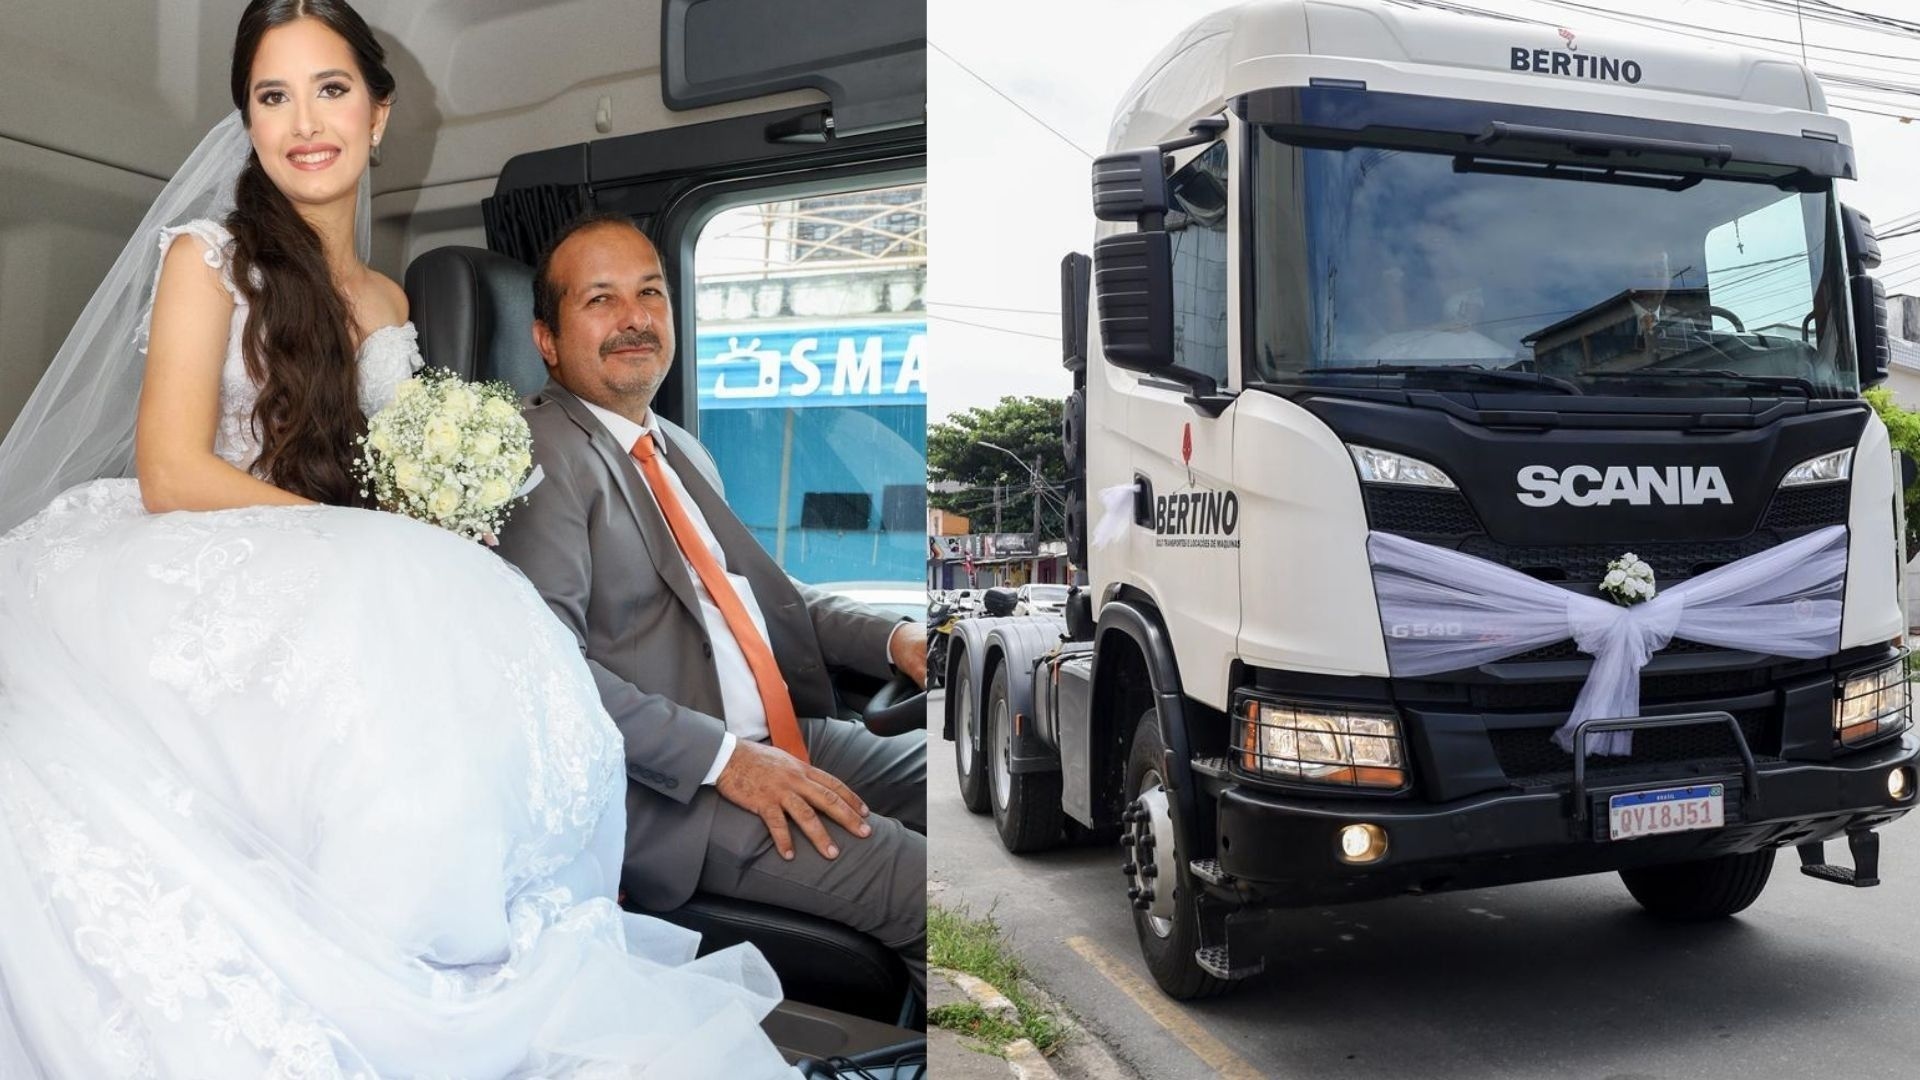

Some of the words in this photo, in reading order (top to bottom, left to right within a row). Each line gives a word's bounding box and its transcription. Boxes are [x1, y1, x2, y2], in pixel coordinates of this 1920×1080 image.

[1510, 47, 1642, 85] BERTINO
[790, 335, 927, 397] SMA
[1516, 464, 1734, 507] SCANIA
[1156, 490, 1239, 536] BERTINO
[1391, 624, 1409, 638] G
[1413, 622, 1462, 637] 540
